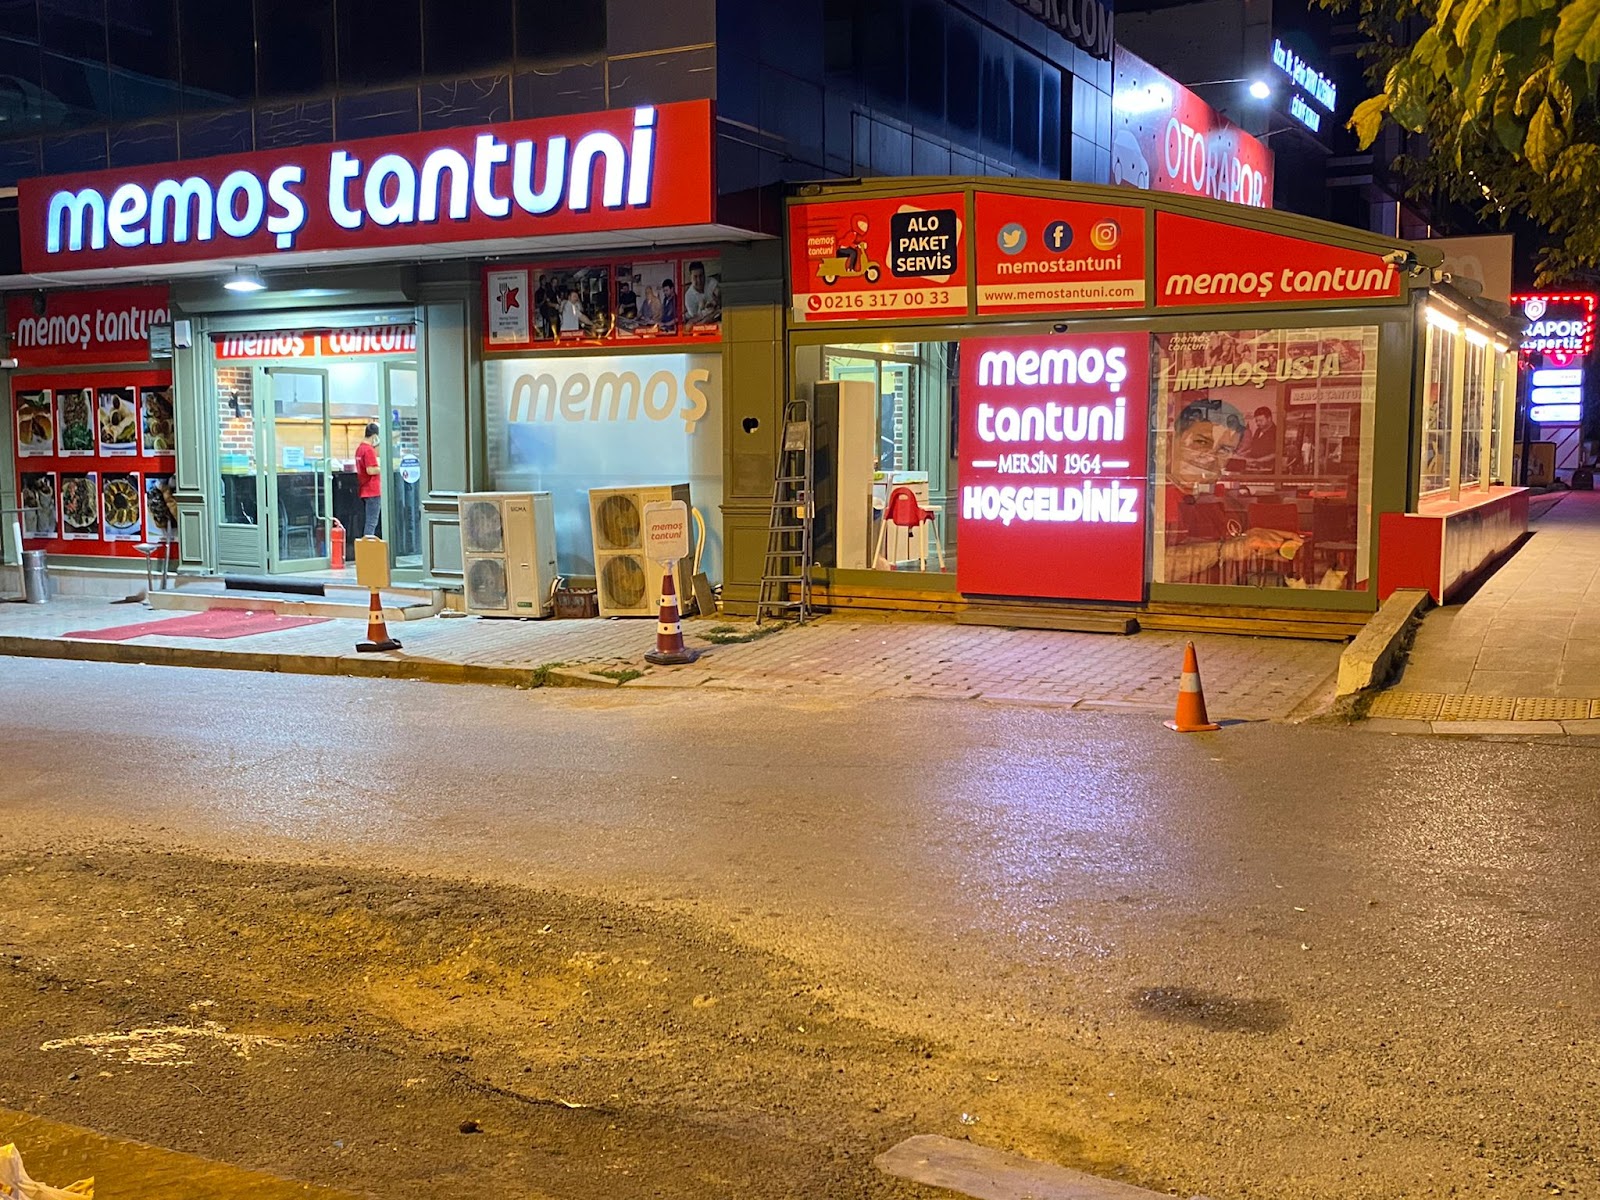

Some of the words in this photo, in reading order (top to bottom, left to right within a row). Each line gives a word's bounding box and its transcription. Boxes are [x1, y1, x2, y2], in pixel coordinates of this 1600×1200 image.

[47, 165, 305, 253] memoş
[328, 105, 655, 230] tantuni
[907, 216, 939, 232] ALO
[899, 234, 950, 252] PAKET
[896, 252, 952, 272] SERVİS
[996, 254, 1122, 275] memostantuni
[984, 285, 1135, 302] www.memostantuni.com
[1164, 271, 1274, 298] memoş
[1279, 263, 1396, 293] tantuni
[824, 294, 864, 309] 0216
[869, 293, 898, 308] 317
[904, 292, 925, 306] 00
[929, 290, 950, 305] 33
[17, 313, 92, 350] memoş
[978, 346, 1128, 393] memoş
[1172, 358, 1270, 393] MEMOŞ
[1275, 352, 1341, 383] USTA
[508, 368, 710, 434] memoş
[977, 396, 1127, 443] tantuni
[997, 450, 1058, 474] MERSİN
[1064, 453, 1102, 475] 1964
[962, 479, 1139, 527] HOŞGELDİNİZ
[650, 530, 683, 541] tantuni
